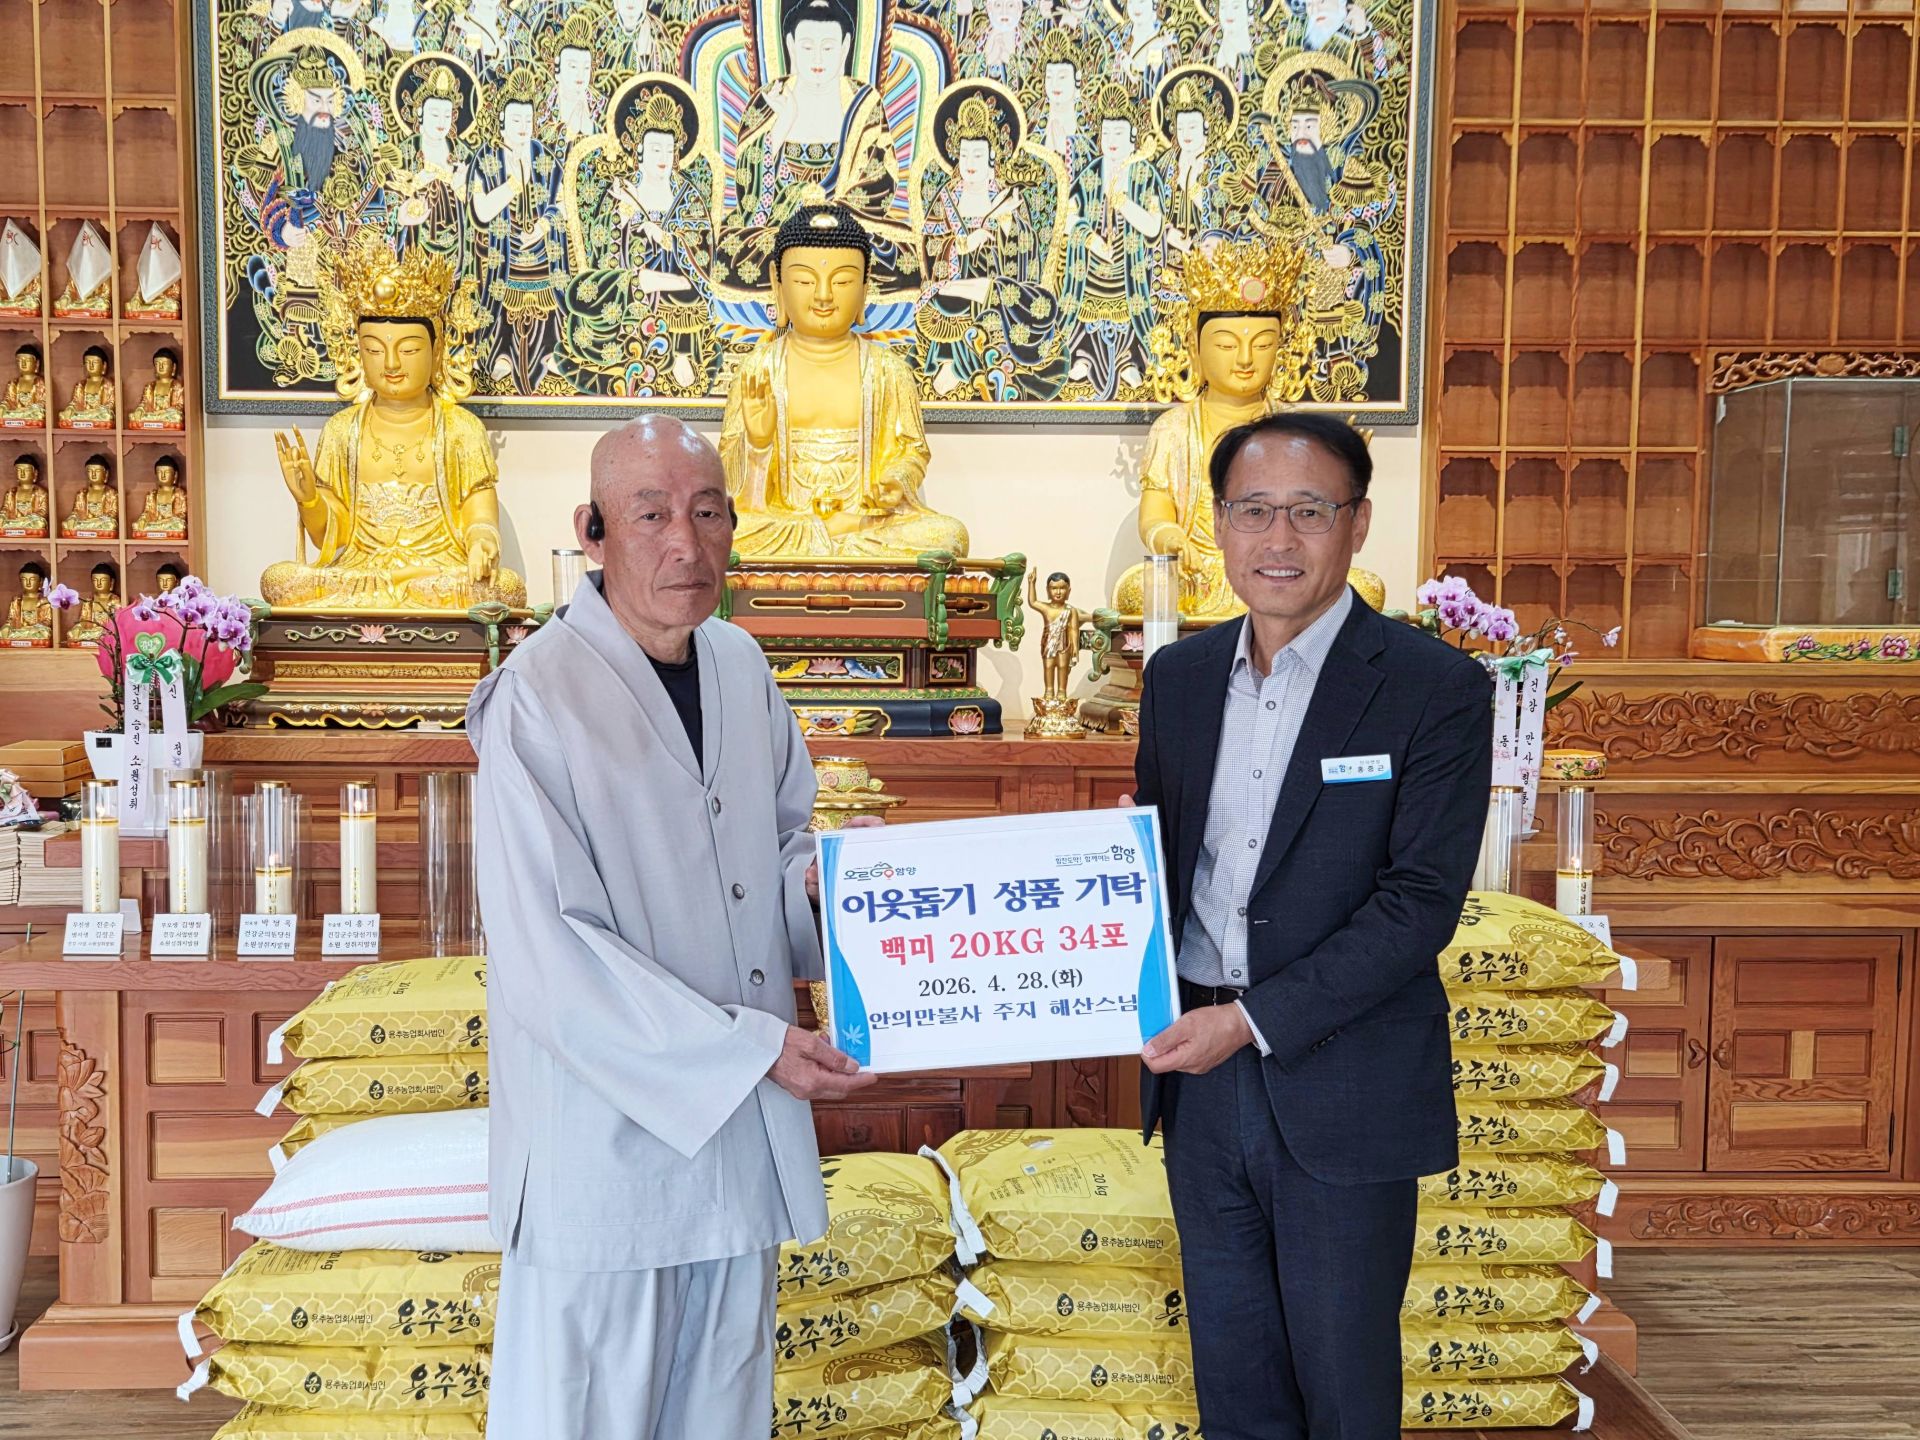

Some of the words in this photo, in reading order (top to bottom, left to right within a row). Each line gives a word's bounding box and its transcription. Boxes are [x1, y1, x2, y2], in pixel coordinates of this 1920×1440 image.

[1110, 844, 1136, 864] 함양
[842, 883, 976, 923] 이웃돕기
[993, 878, 1064, 913] 성품
[1075, 872, 1147, 906] 기탁
[880, 934, 934, 966] 백미
[949, 927, 1044, 960] 20KG
[1059, 921, 1129, 952] 34포
[1452, 952, 1522, 983] 용추쌀
[918, 976, 976, 998] 2026.
[987, 974, 1007, 992] 4.
[1017, 968, 1084, 990] 28.(화)
[869, 1004, 982, 1031] 안의만불사
[992, 1000, 1036, 1022] 주지
[1048, 994, 1138, 1016] 해산스님
[1449, 1007, 1520, 1038] 용추쌀
[388, 1028, 445, 1038] 용추농업회사법인
[386, 1084, 444, 1095] 용추농업회사법인
[1457, 1116, 1511, 1145] 추쌀
[1439, 1169, 1510, 1199] 용추쌀
[1100, 1236, 1164, 1249] 용추농업회사법인
[1428, 1224, 1499, 1256] 용추쌀
[1077, 1301, 1140, 1313] 용추농업회사법인
[1426, 1286, 1496, 1318] 용추쌀
[310, 1313, 374, 1324] 용추농업회사법인
[389, 1298, 472, 1337] 용추쌀
[775, 1310, 848, 1360] 용추쌀
[1420, 1342, 1490, 1372] 용추쌀
[402, 1362, 484, 1400] 용추쌀
[1111, 1372, 1174, 1384] 용추농업회사법인
[1412, 1392, 1484, 1422] 용추쌀
